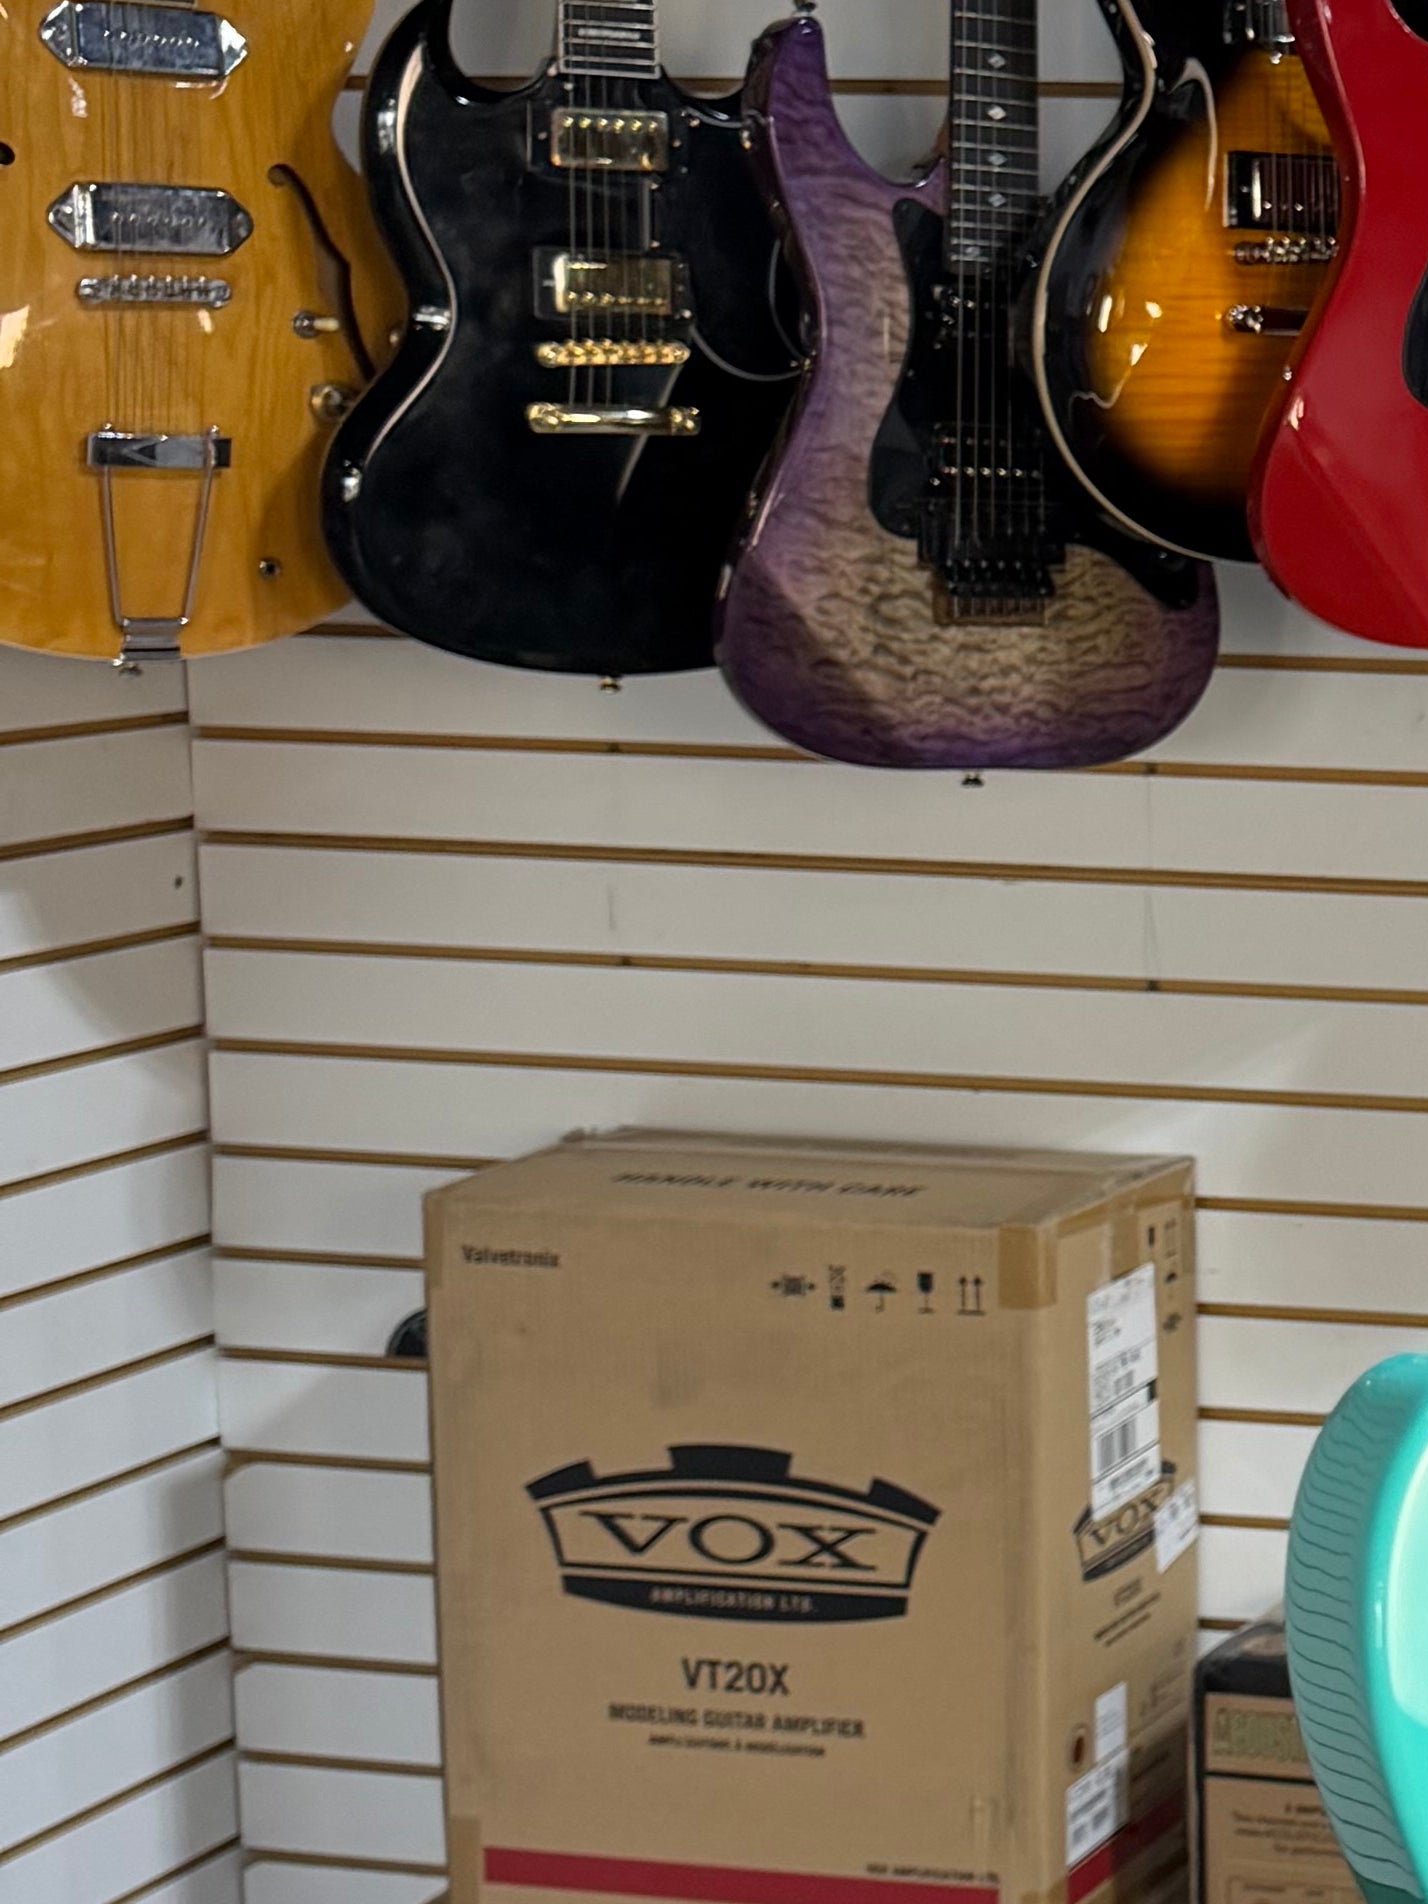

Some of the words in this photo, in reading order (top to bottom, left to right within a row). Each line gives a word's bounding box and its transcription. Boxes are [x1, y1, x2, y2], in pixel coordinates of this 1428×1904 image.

[579, 1510, 877, 1571] VOX
[682, 1657, 790, 1696] VT20X
[702, 1708, 766, 1731] GUITAR
[771, 1715, 865, 1739] AMPLIFIER
